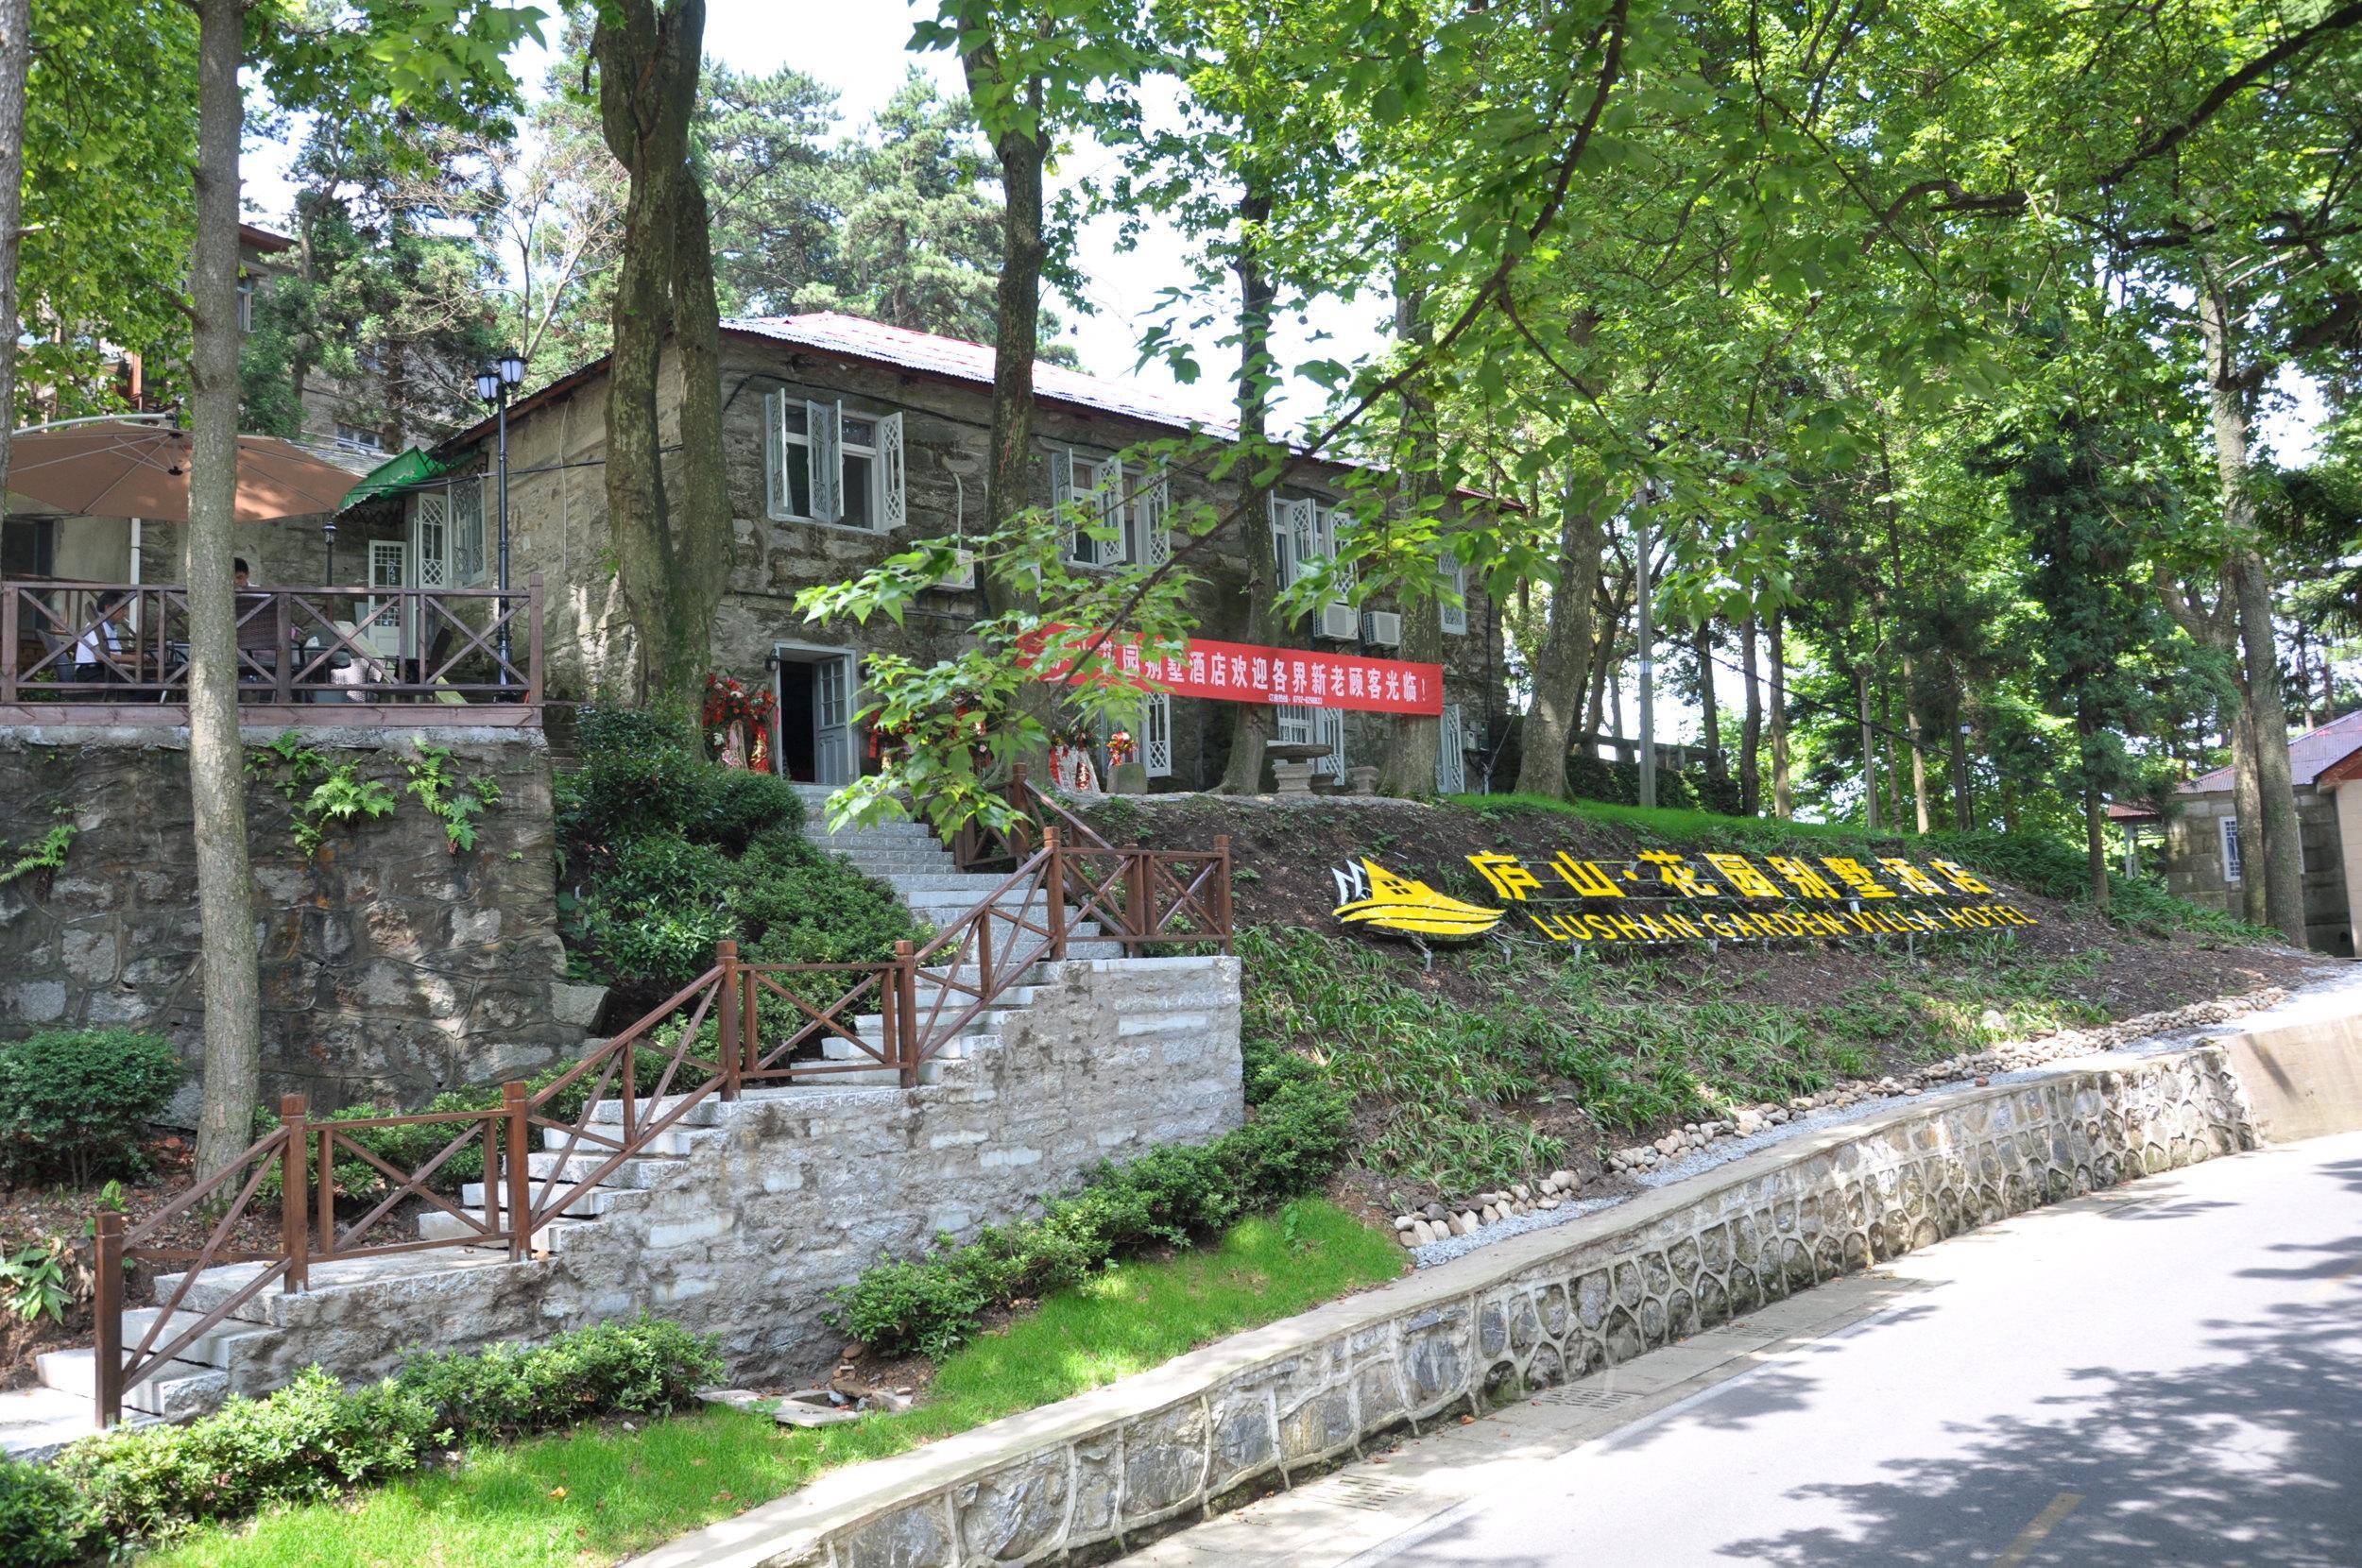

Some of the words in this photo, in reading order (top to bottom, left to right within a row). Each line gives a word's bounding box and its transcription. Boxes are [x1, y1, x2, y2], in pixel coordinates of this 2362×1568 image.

[1050, 637, 1426, 702] 园别墅酒店欢迎各界新老顾客光临！
[1529, 913, 1703, 941] LUSHAN
[1702, 912, 1850, 938] GARDEN
[1841, 910, 1944, 933] VILLA
[1937, 905, 2038, 928] HOTEL
